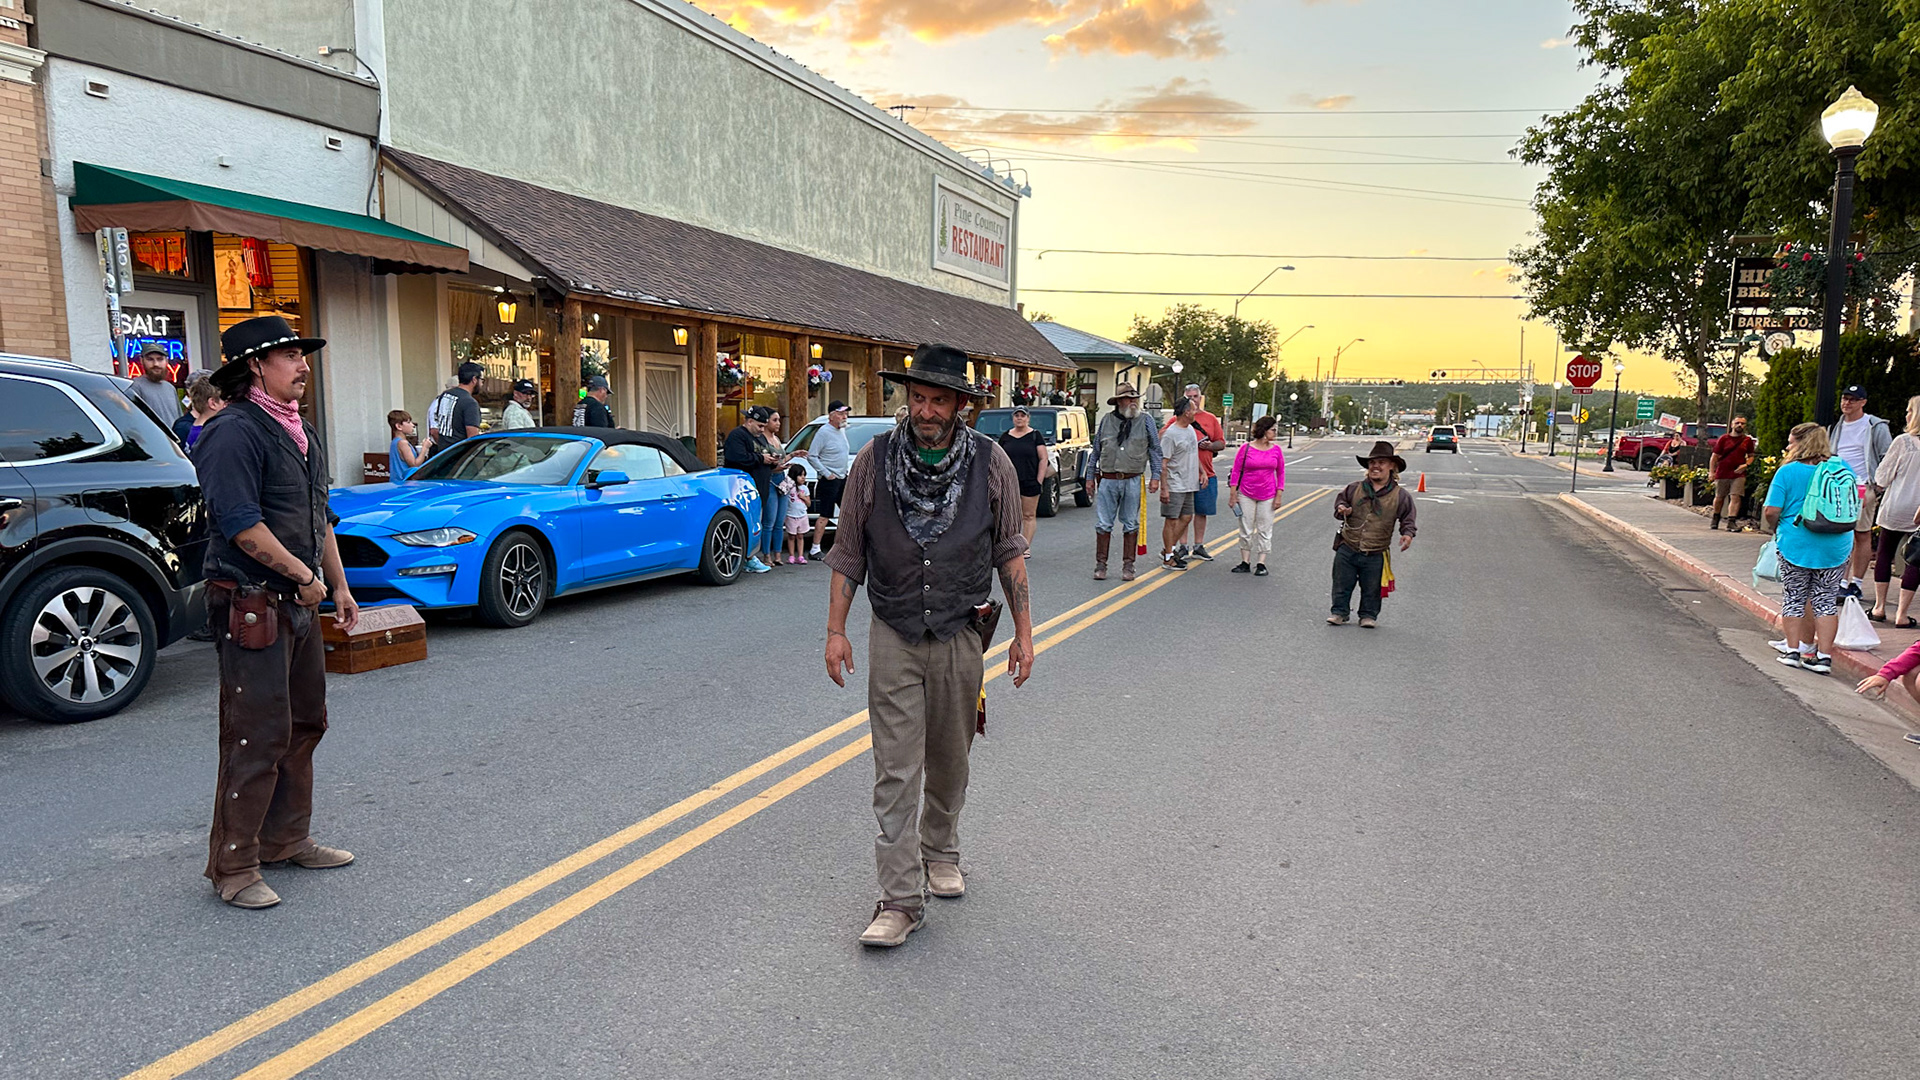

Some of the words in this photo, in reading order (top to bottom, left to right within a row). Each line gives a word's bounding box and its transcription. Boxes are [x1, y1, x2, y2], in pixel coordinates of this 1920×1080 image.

[954, 203, 972, 223] Pine
[975, 213, 1004, 239] Country
[952, 225, 1005, 269] RESTAURANT
[120, 313, 170, 336] SALT
[1568, 364, 1600, 378] STOP
